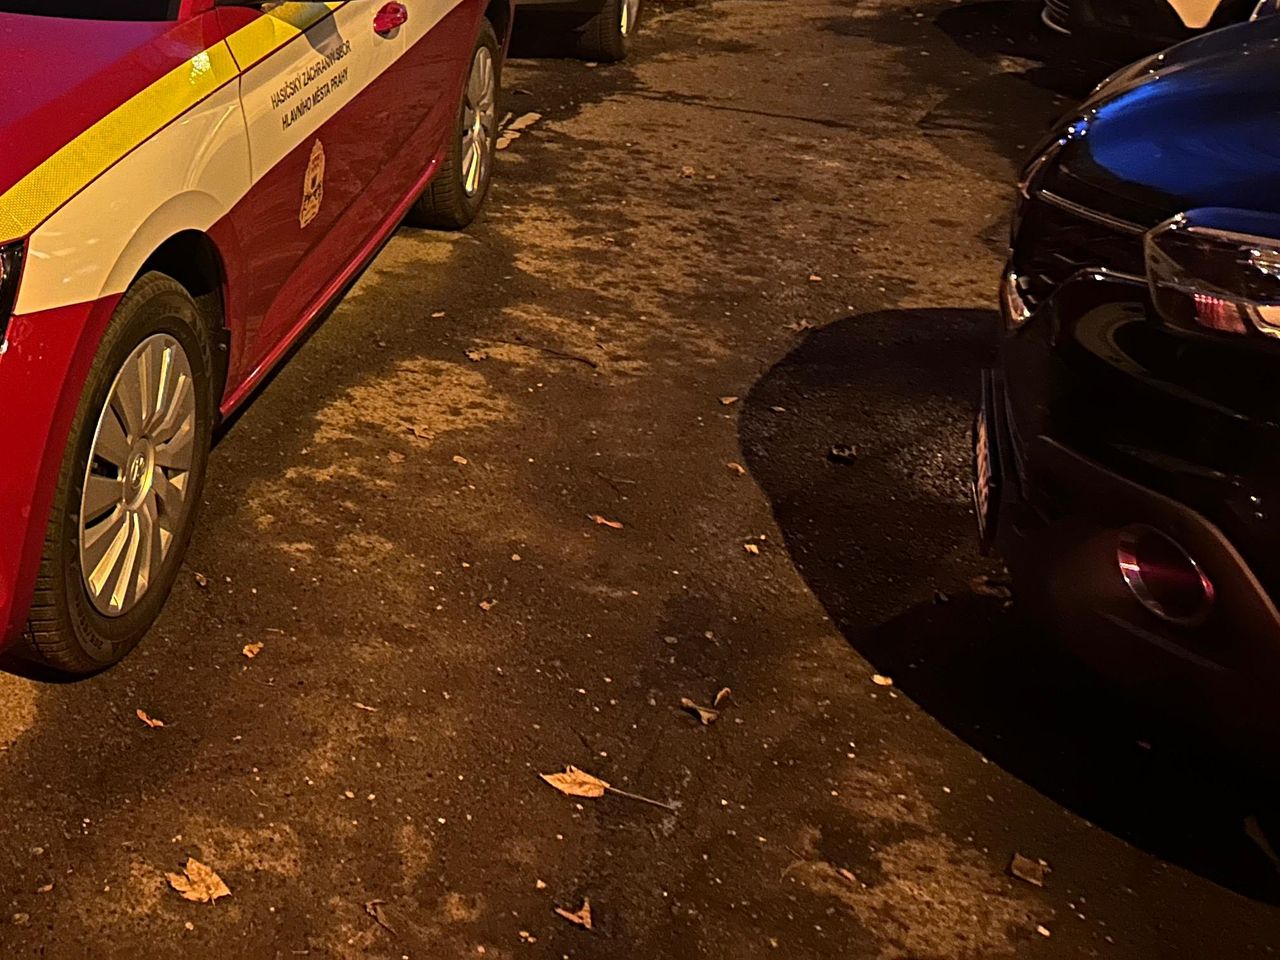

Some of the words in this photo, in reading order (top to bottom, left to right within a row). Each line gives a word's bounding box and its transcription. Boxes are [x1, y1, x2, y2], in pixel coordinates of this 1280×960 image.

[271, 74, 302, 109] HASIČSKÝ
[282, 97, 312, 130] HLAVNÍHO
[312, 86, 331, 107] MĚSTA
[331, 67, 348, 91] PRAHY
